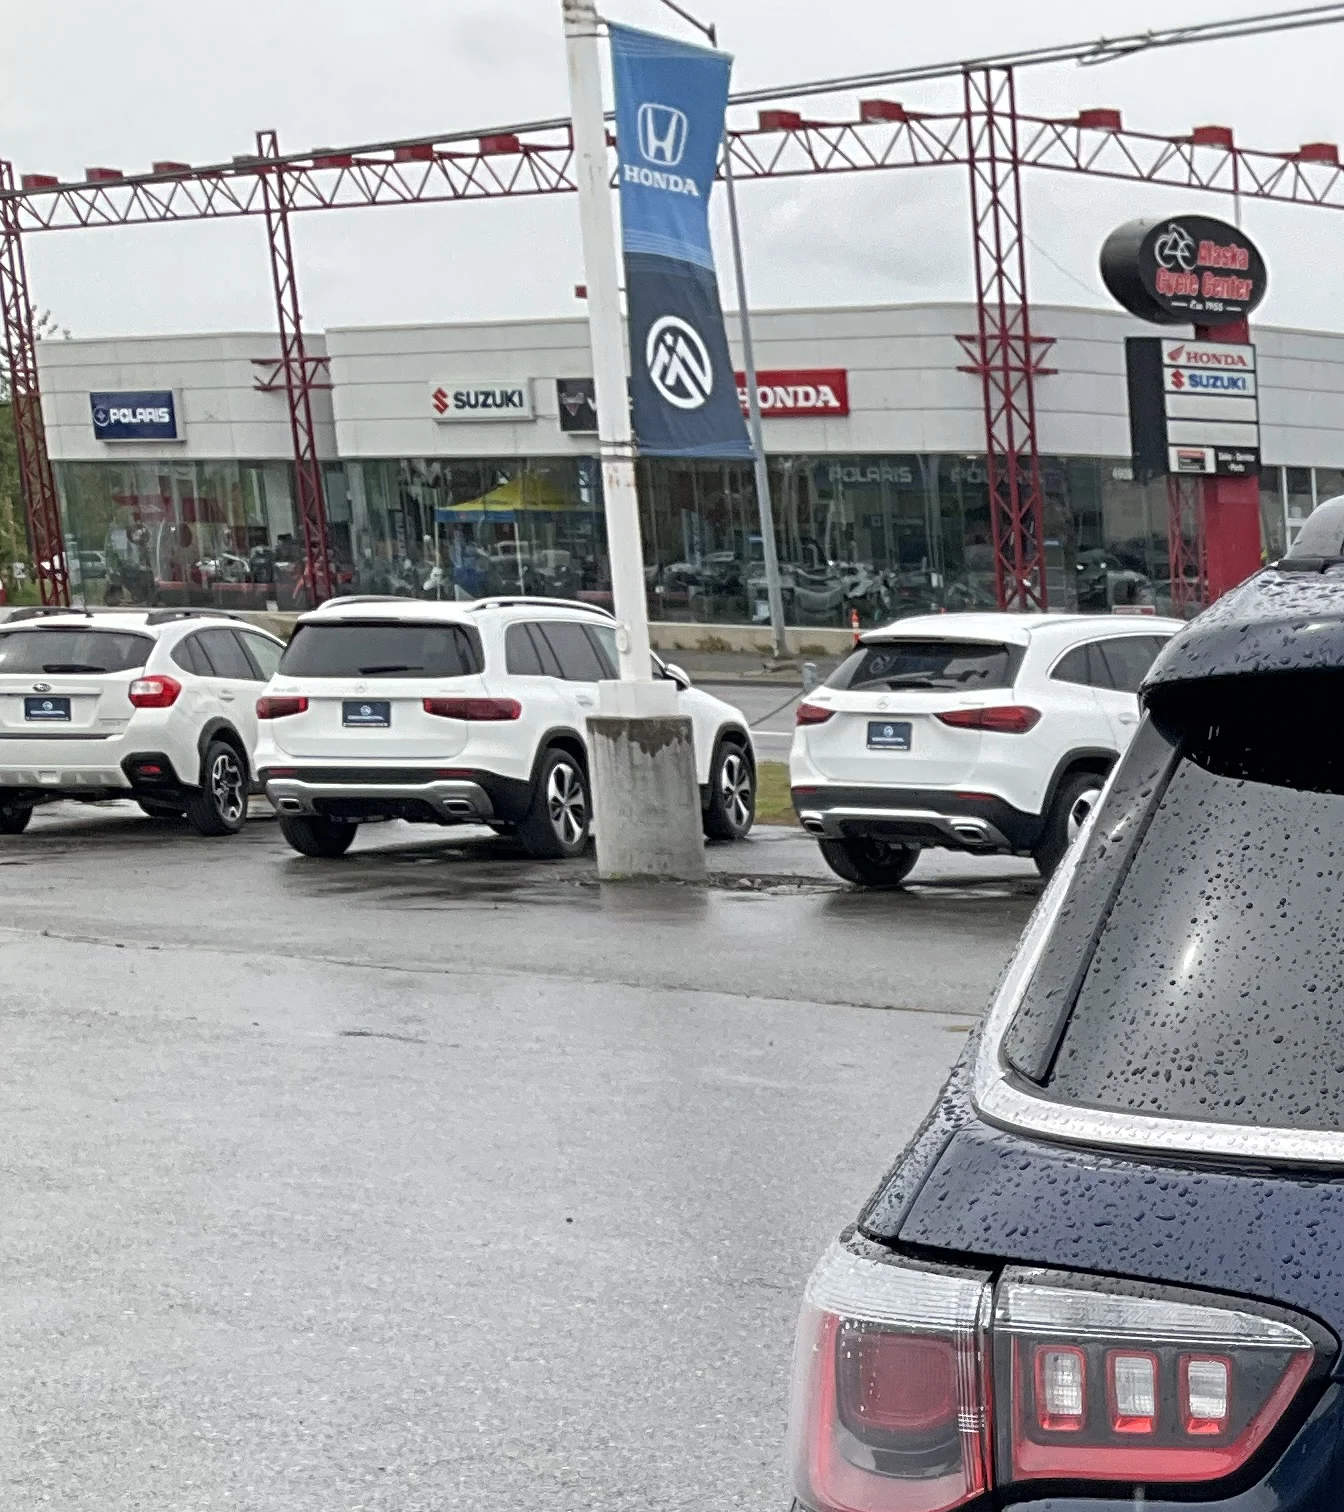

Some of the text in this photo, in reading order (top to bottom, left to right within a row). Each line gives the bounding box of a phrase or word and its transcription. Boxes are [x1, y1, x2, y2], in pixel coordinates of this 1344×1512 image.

[623, 163, 699, 197] HONDA
[1155, 267, 1252, 301] Cycle Center
[1186, 351, 1248, 367] HONDA
[1188, 373, 1247, 390] SUZUKI
[453, 389, 524, 409] SUZUKI
[109, 407, 170, 424] POLARIS
[828, 466, 913, 483] POLARIS
